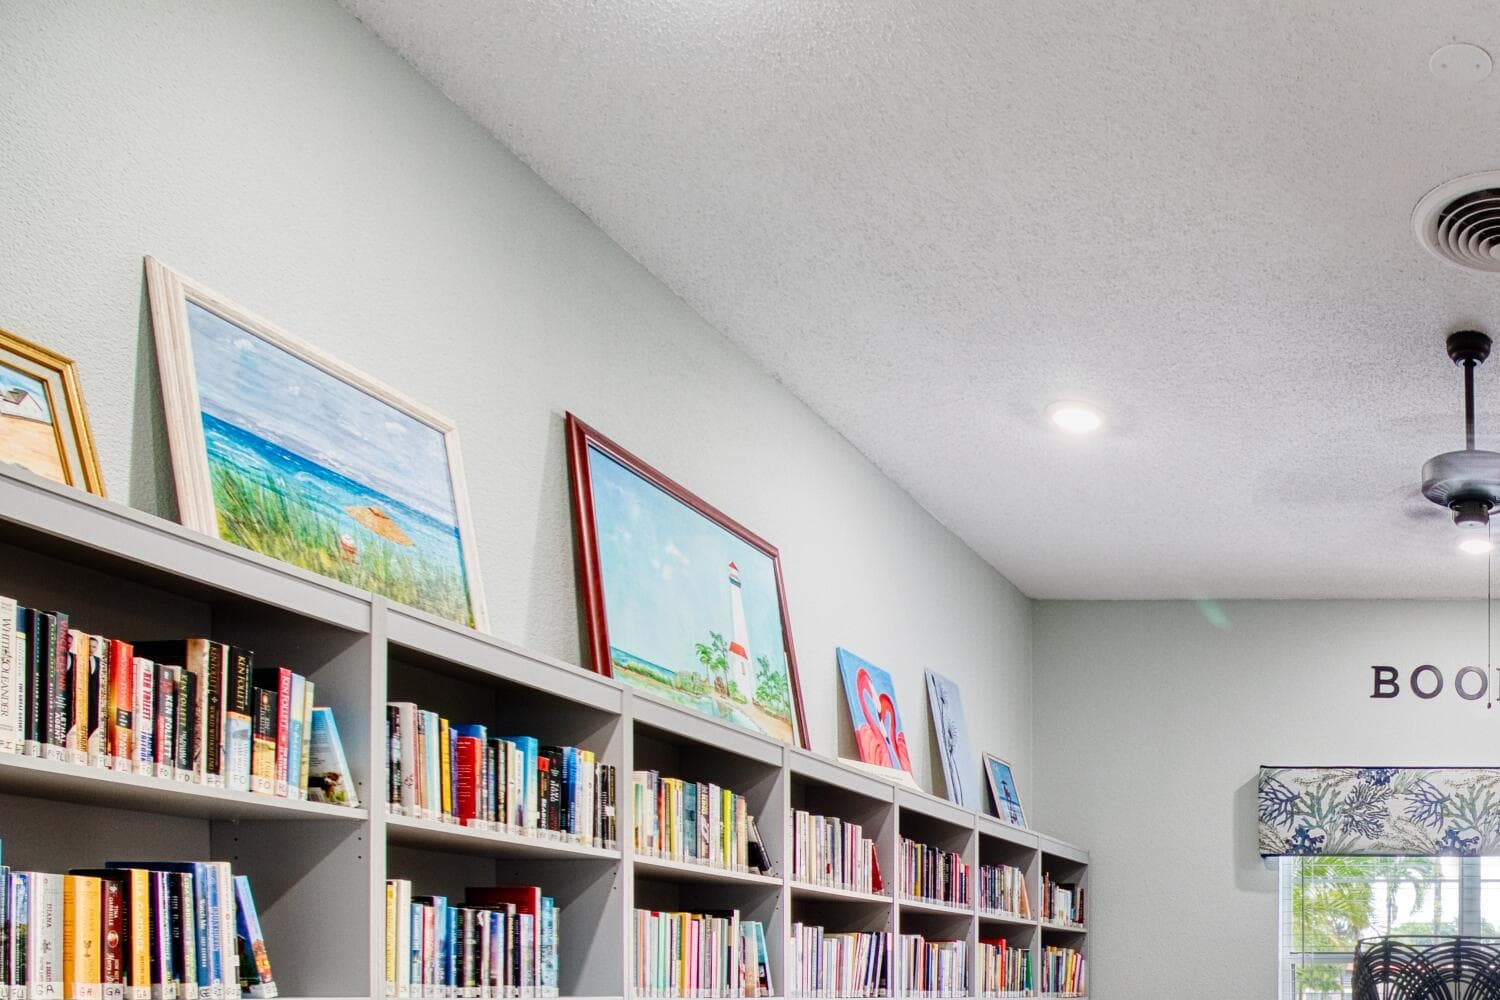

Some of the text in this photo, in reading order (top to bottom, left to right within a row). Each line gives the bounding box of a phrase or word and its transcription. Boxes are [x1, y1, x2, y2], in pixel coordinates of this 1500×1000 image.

[1, 656, 12, 717] OLEANDER
[142, 672, 152, 721] KEN FOLLETT
[178, 673, 188, 727] KEN FOLLETT
[235, 656, 247, 711] KEN FOLLETT
[279, 675, 291, 729] KEN FOLLETT
[164, 694, 174, 757] KEN FOLLETT
[233, 775, 246, 785] FO
[258, 779, 271, 790] FO
[106, 987, 121, 996] GA
